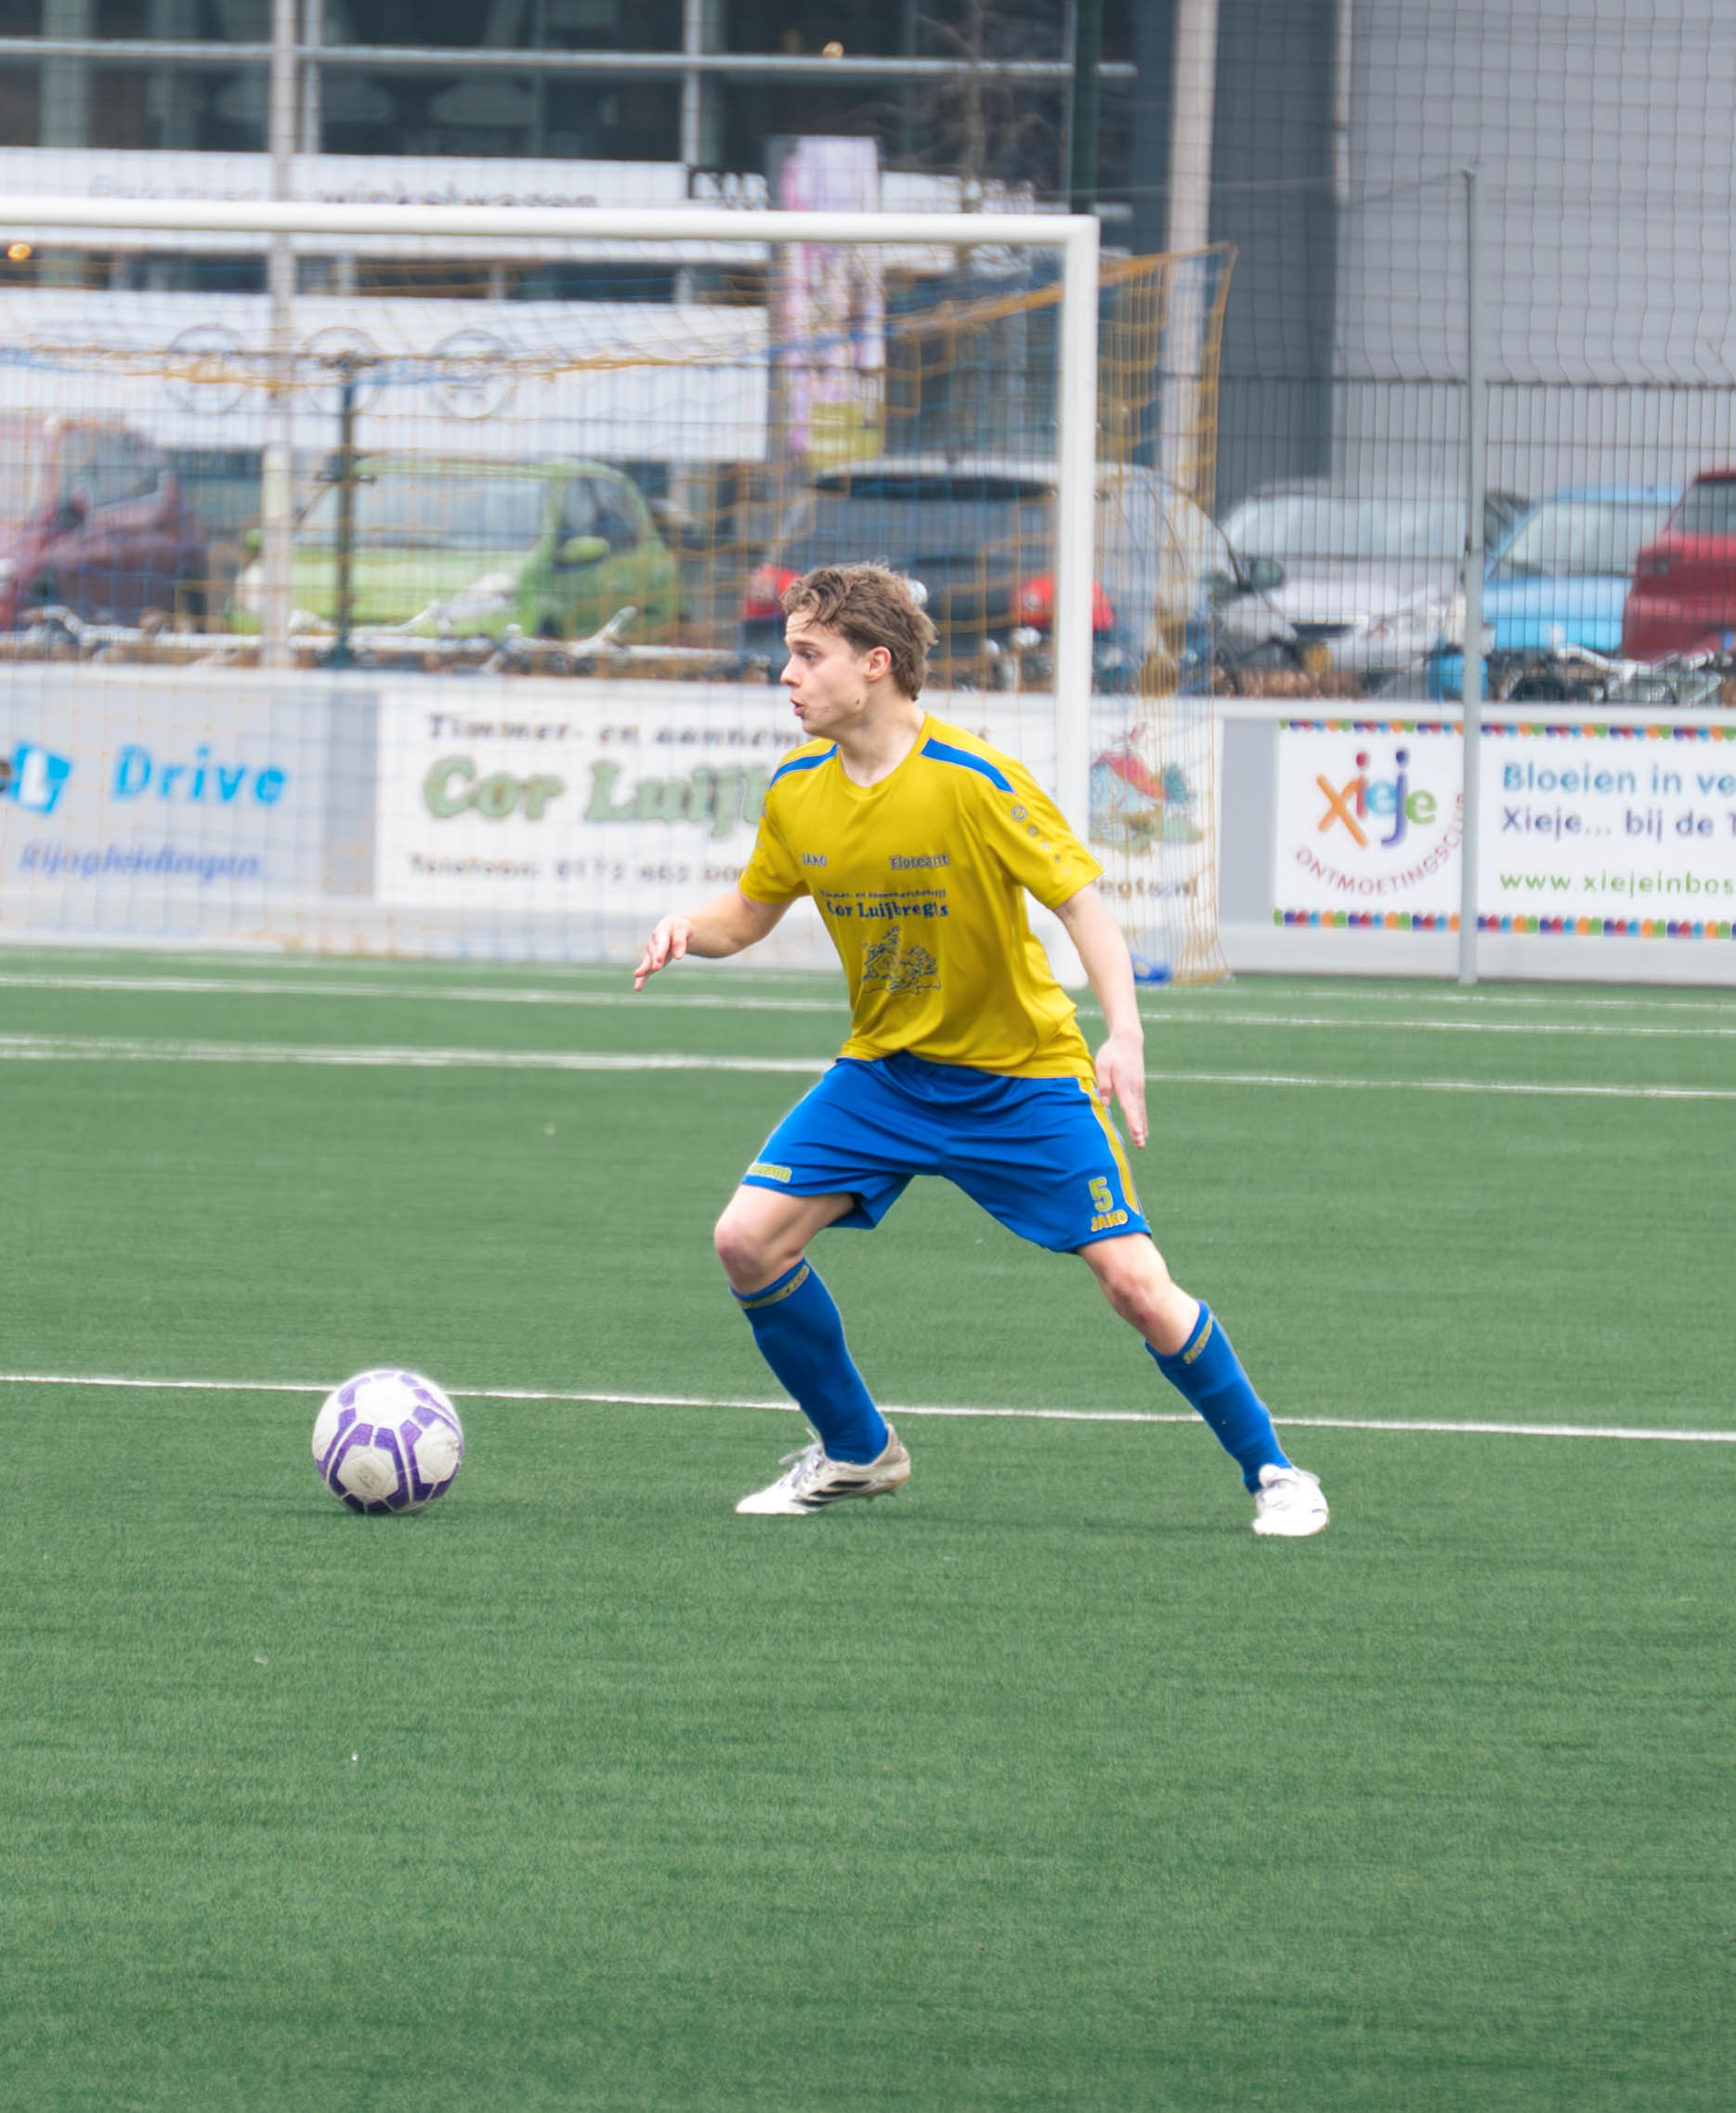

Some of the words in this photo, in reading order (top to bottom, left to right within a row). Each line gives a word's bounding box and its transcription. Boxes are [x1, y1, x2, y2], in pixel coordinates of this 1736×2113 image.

[111, 744, 288, 803] Drive
[424, 755, 567, 821] Cor
[1502, 760, 1638, 795] Bloeien
[1651, 763, 1683, 796] in
[1625, 806, 1664, 844] bij
[1675, 808, 1715, 838] de
[1089, 1176, 1114, 1212] 5
[1090, 1209, 1129, 1233] JAKO
